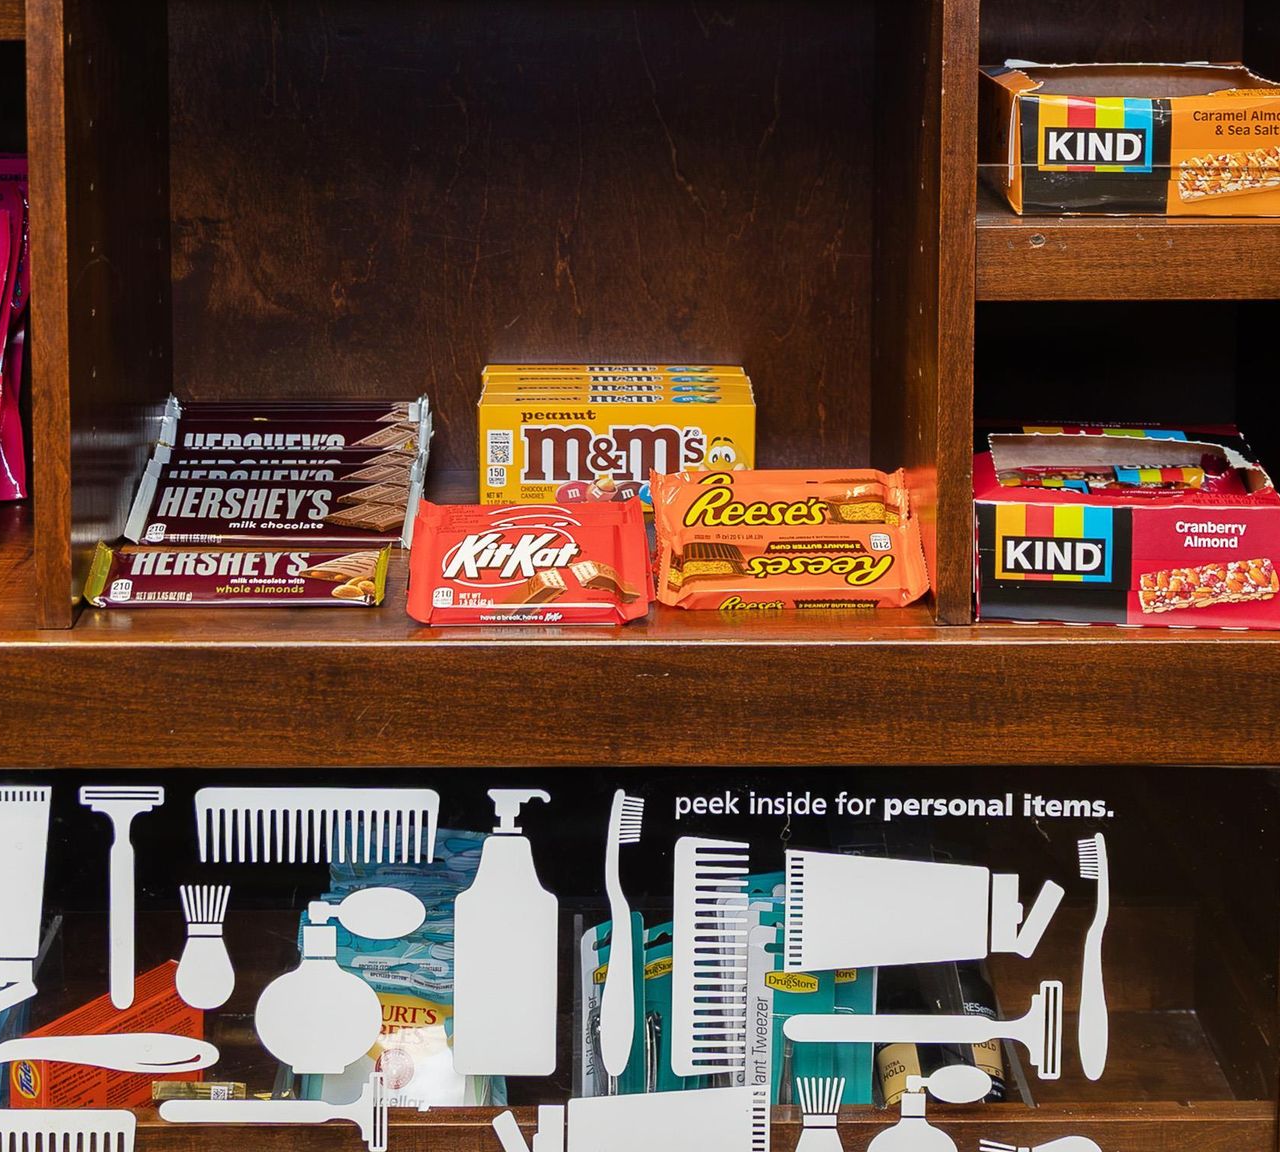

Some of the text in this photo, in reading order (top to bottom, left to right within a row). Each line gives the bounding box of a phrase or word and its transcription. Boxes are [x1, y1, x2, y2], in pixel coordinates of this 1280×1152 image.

[1193, 109, 1247, 122] Caramel
[1215, 124, 1280, 136] & Sea Salt
[1048, 133, 1143, 162] KIND
[520, 409, 597, 423] peanut
[489, 468, 505, 478] 150
[157, 485, 334, 520] HERSHEY'S
[686, 487, 828, 526] Reese's
[149, 525, 165, 533] 210
[228, 520, 324, 530] milk chocolate
[1175, 520, 1247, 536] Cranberry
[1183, 535, 1239, 549] Almond
[442, 532, 579, 579] KitKat
[1005, 540, 1103, 572] KIND
[130, 552, 311, 576] HERSHEY'S
[746, 555, 893, 586] Reese's
[113, 582, 130, 591] 210
[248, 577, 285, 585] chocolate
[285, 577, 306, 585] with
[216, 584, 305, 594] whole almonds
[434, 590, 452, 598] 210
[675, 791, 1115, 821] peek inside for personal items.
[768, 975, 816, 989] DrugStore
[751, 996, 769, 1055] Tweezer
[883, 1064, 906, 1082] HOLD
